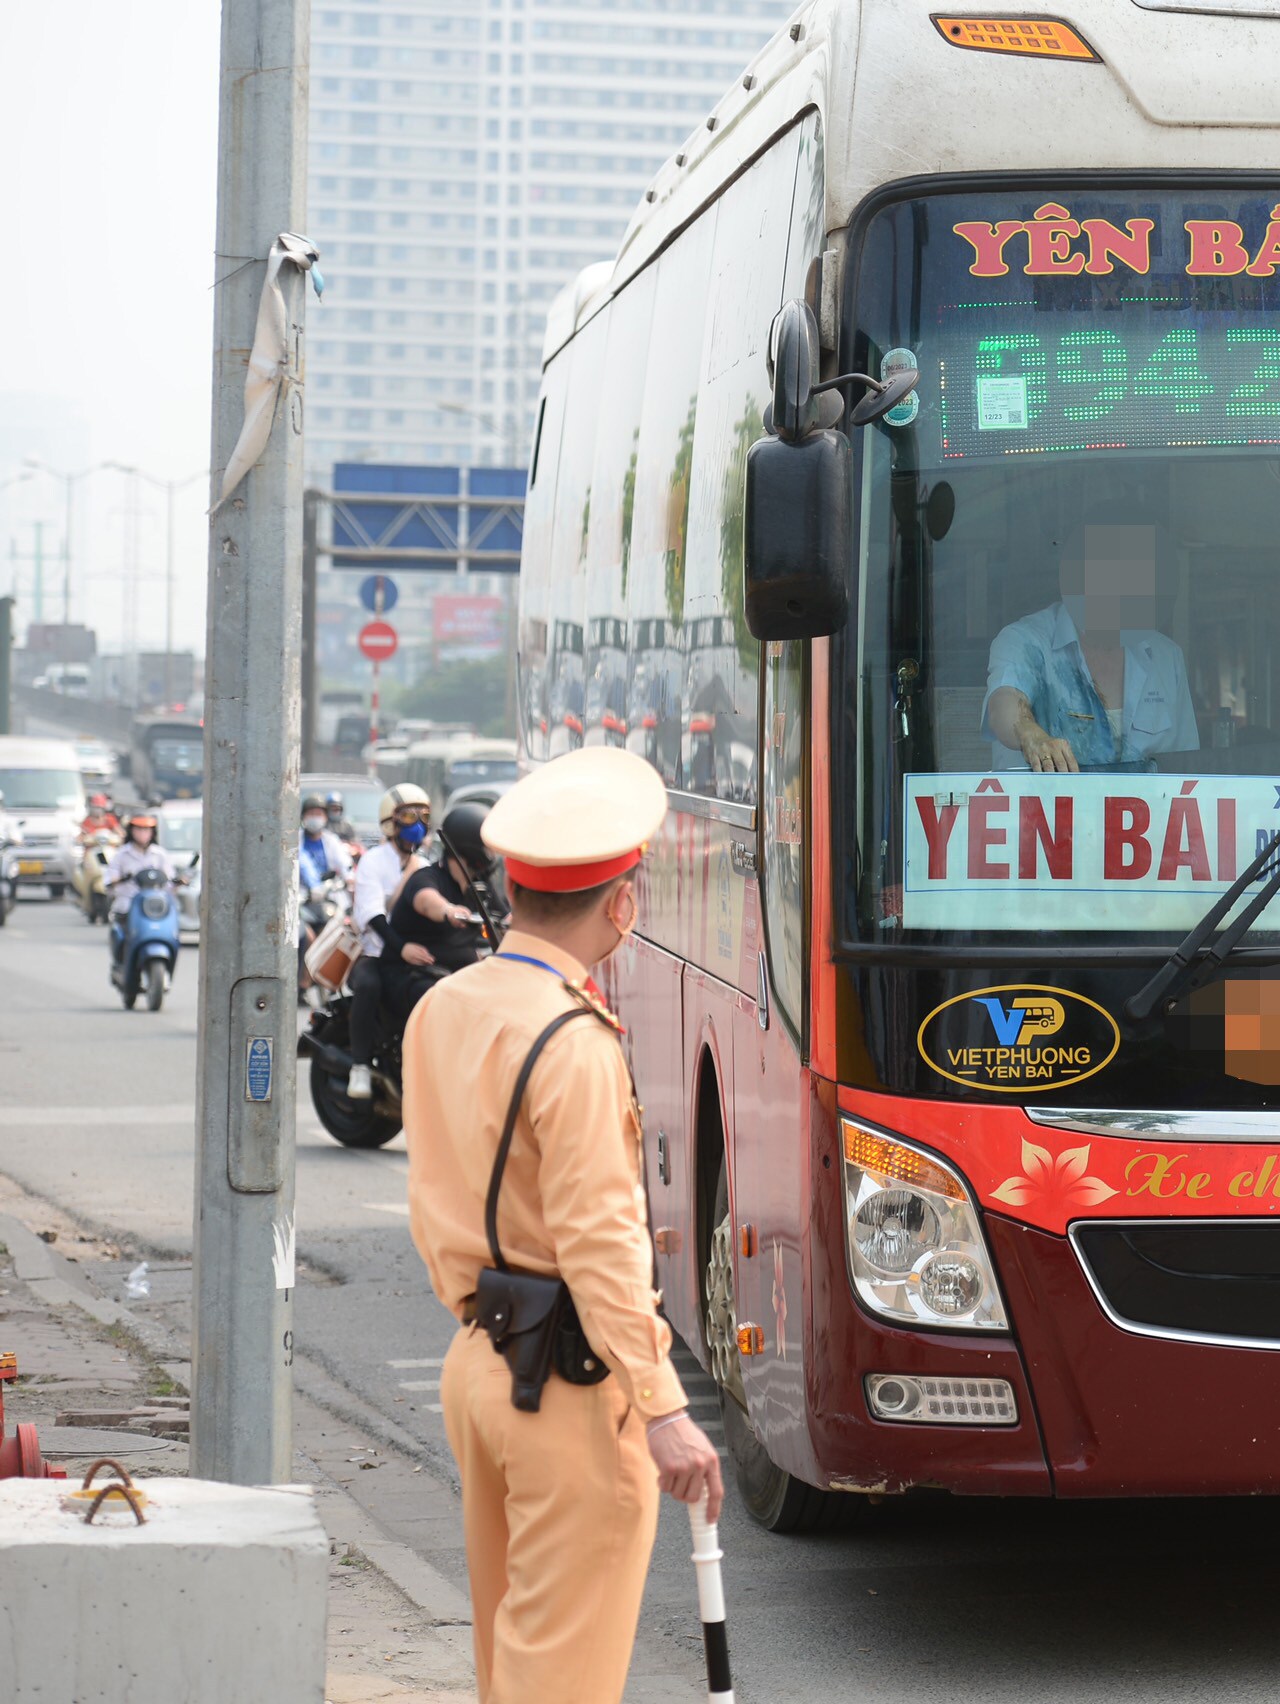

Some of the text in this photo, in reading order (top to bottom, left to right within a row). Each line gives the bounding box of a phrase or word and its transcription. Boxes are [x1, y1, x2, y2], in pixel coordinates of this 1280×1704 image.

[953, 202, 1155, 276] YÊN
[984, 413, 1003, 421] 12/23
[915, 779, 1238, 882] YÊN BÁI
[947, 1047, 1091, 1066] VIETPHUONG
[984, 1066, 1053, 1079] YEN BAI
[1124, 1153, 1214, 1199] Xe
